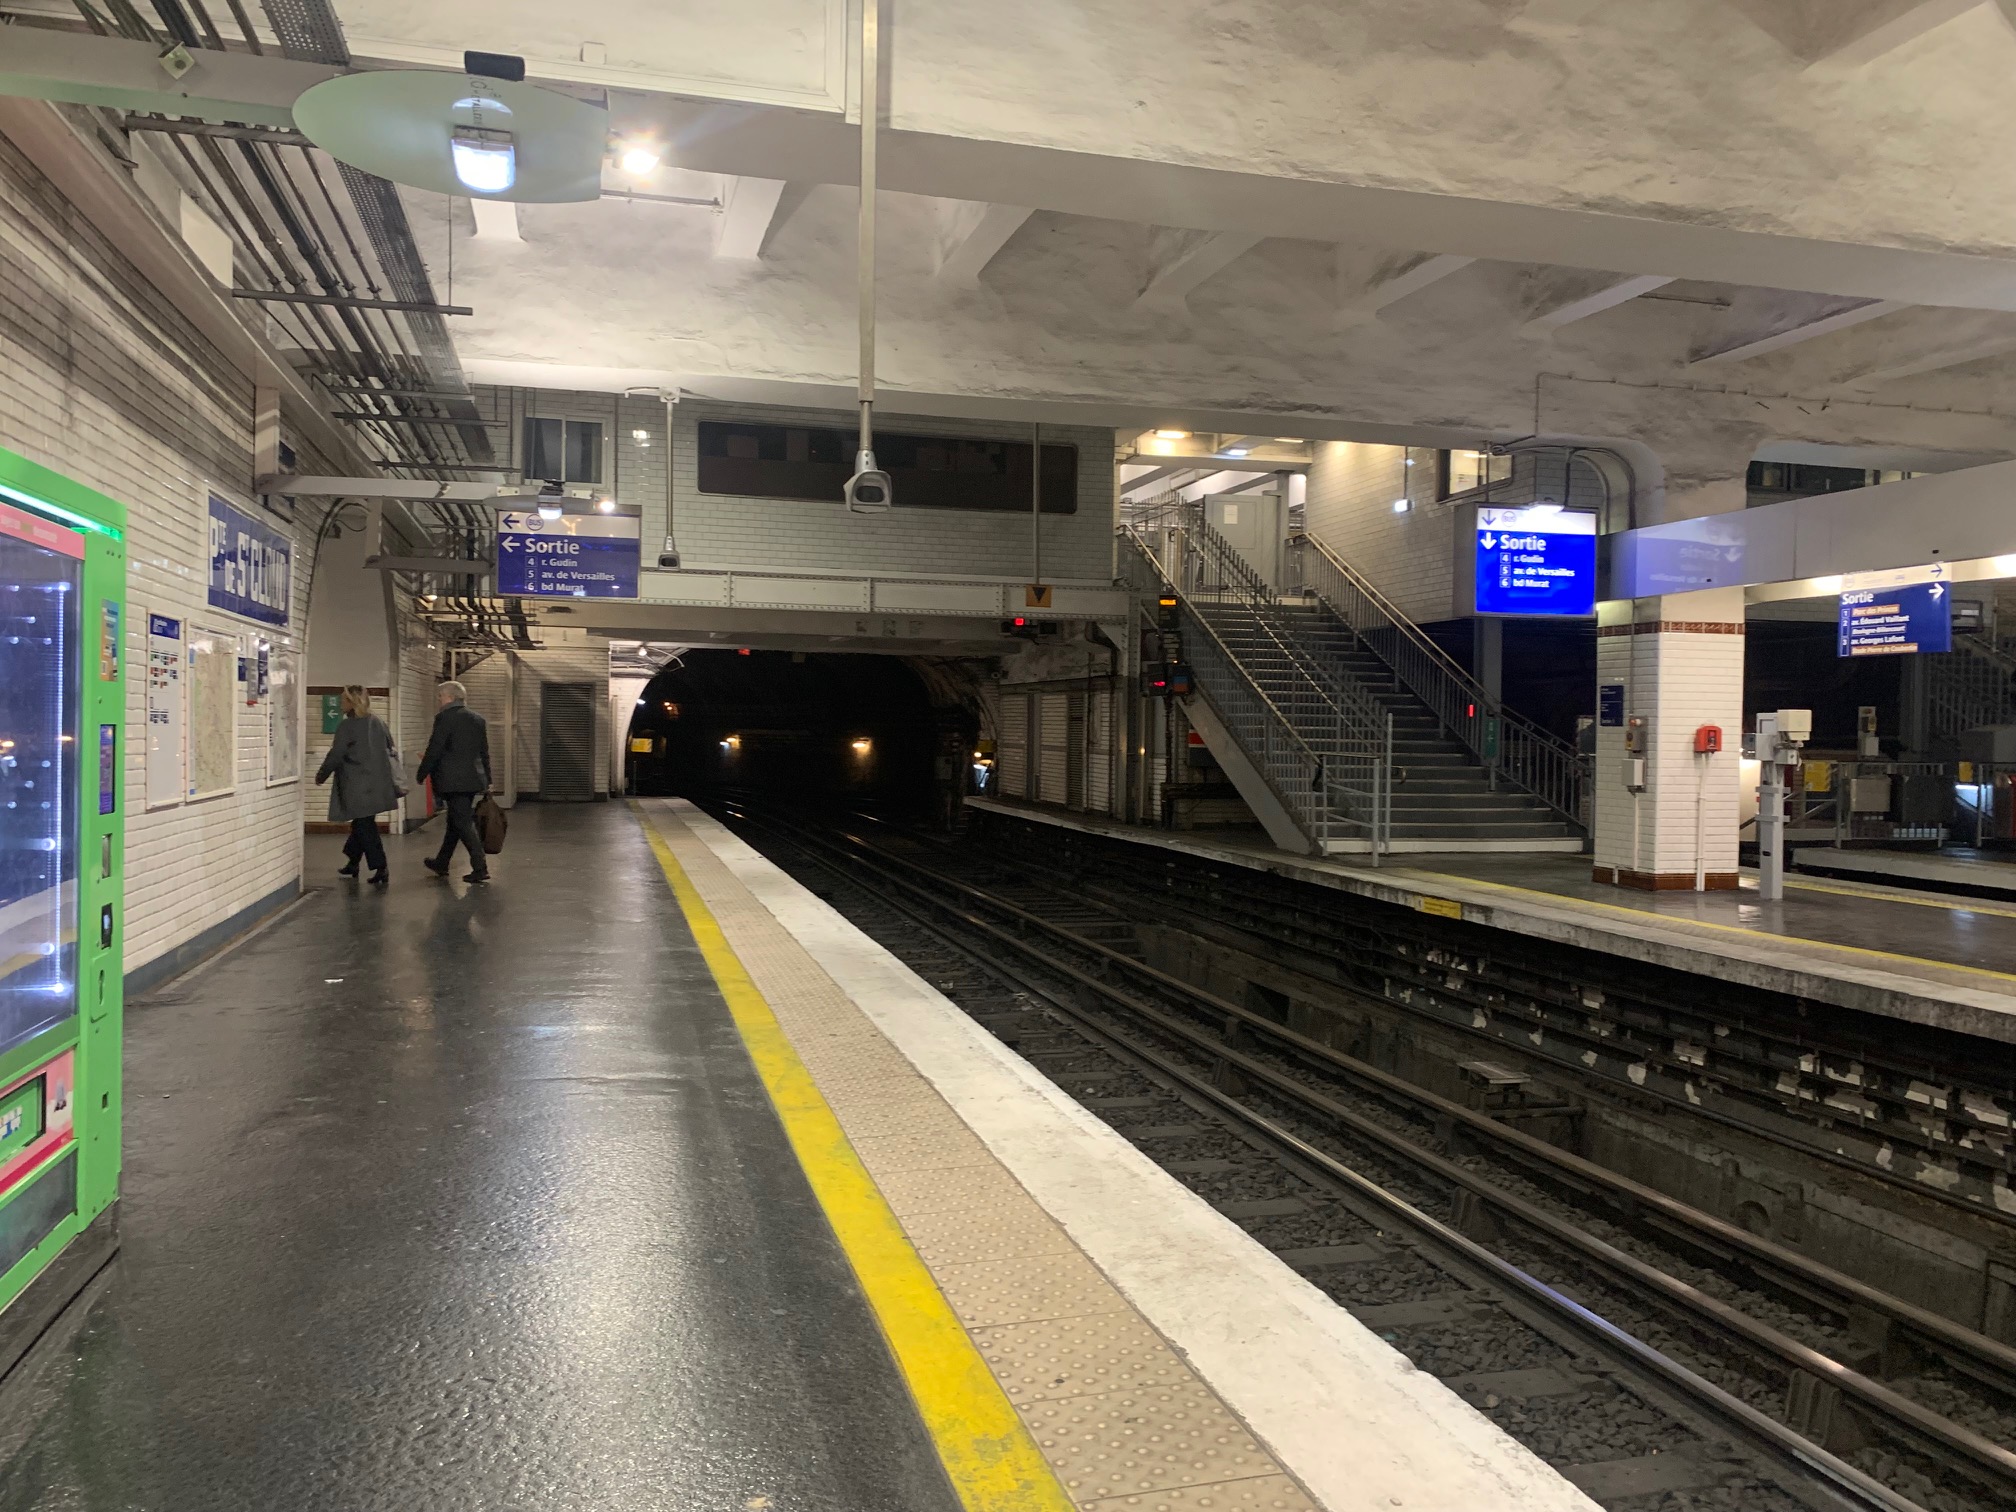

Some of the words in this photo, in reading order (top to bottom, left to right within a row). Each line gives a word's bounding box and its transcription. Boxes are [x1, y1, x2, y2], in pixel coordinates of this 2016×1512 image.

[528, 518, 542, 526] BUS
[525, 538, 580, 555] Sortie
[1500, 534, 1547, 551] Sortie
[527, 558, 535, 566] 4
[541, 559, 548, 567] r.
[549, 558, 578, 567] Gudin
[1501, 554, 1509, 562] 4
[527, 570, 535, 578] 5
[541, 572, 555, 580] av.
[556, 571, 568, 579] de
[570, 572, 616, 581] Versailles
[1501, 566, 1509, 574] 5
[1525, 566, 1537, 575] de
[225, 559, 236, 594] DE
[527, 583, 535, 591] 6
[541, 582, 554, 591] bd
[556, 583, 585, 592] Murat
[1501, 578, 1509, 587] 6
[1513, 578, 1525, 587] bd
[1842, 591, 1874, 605] Sortie
